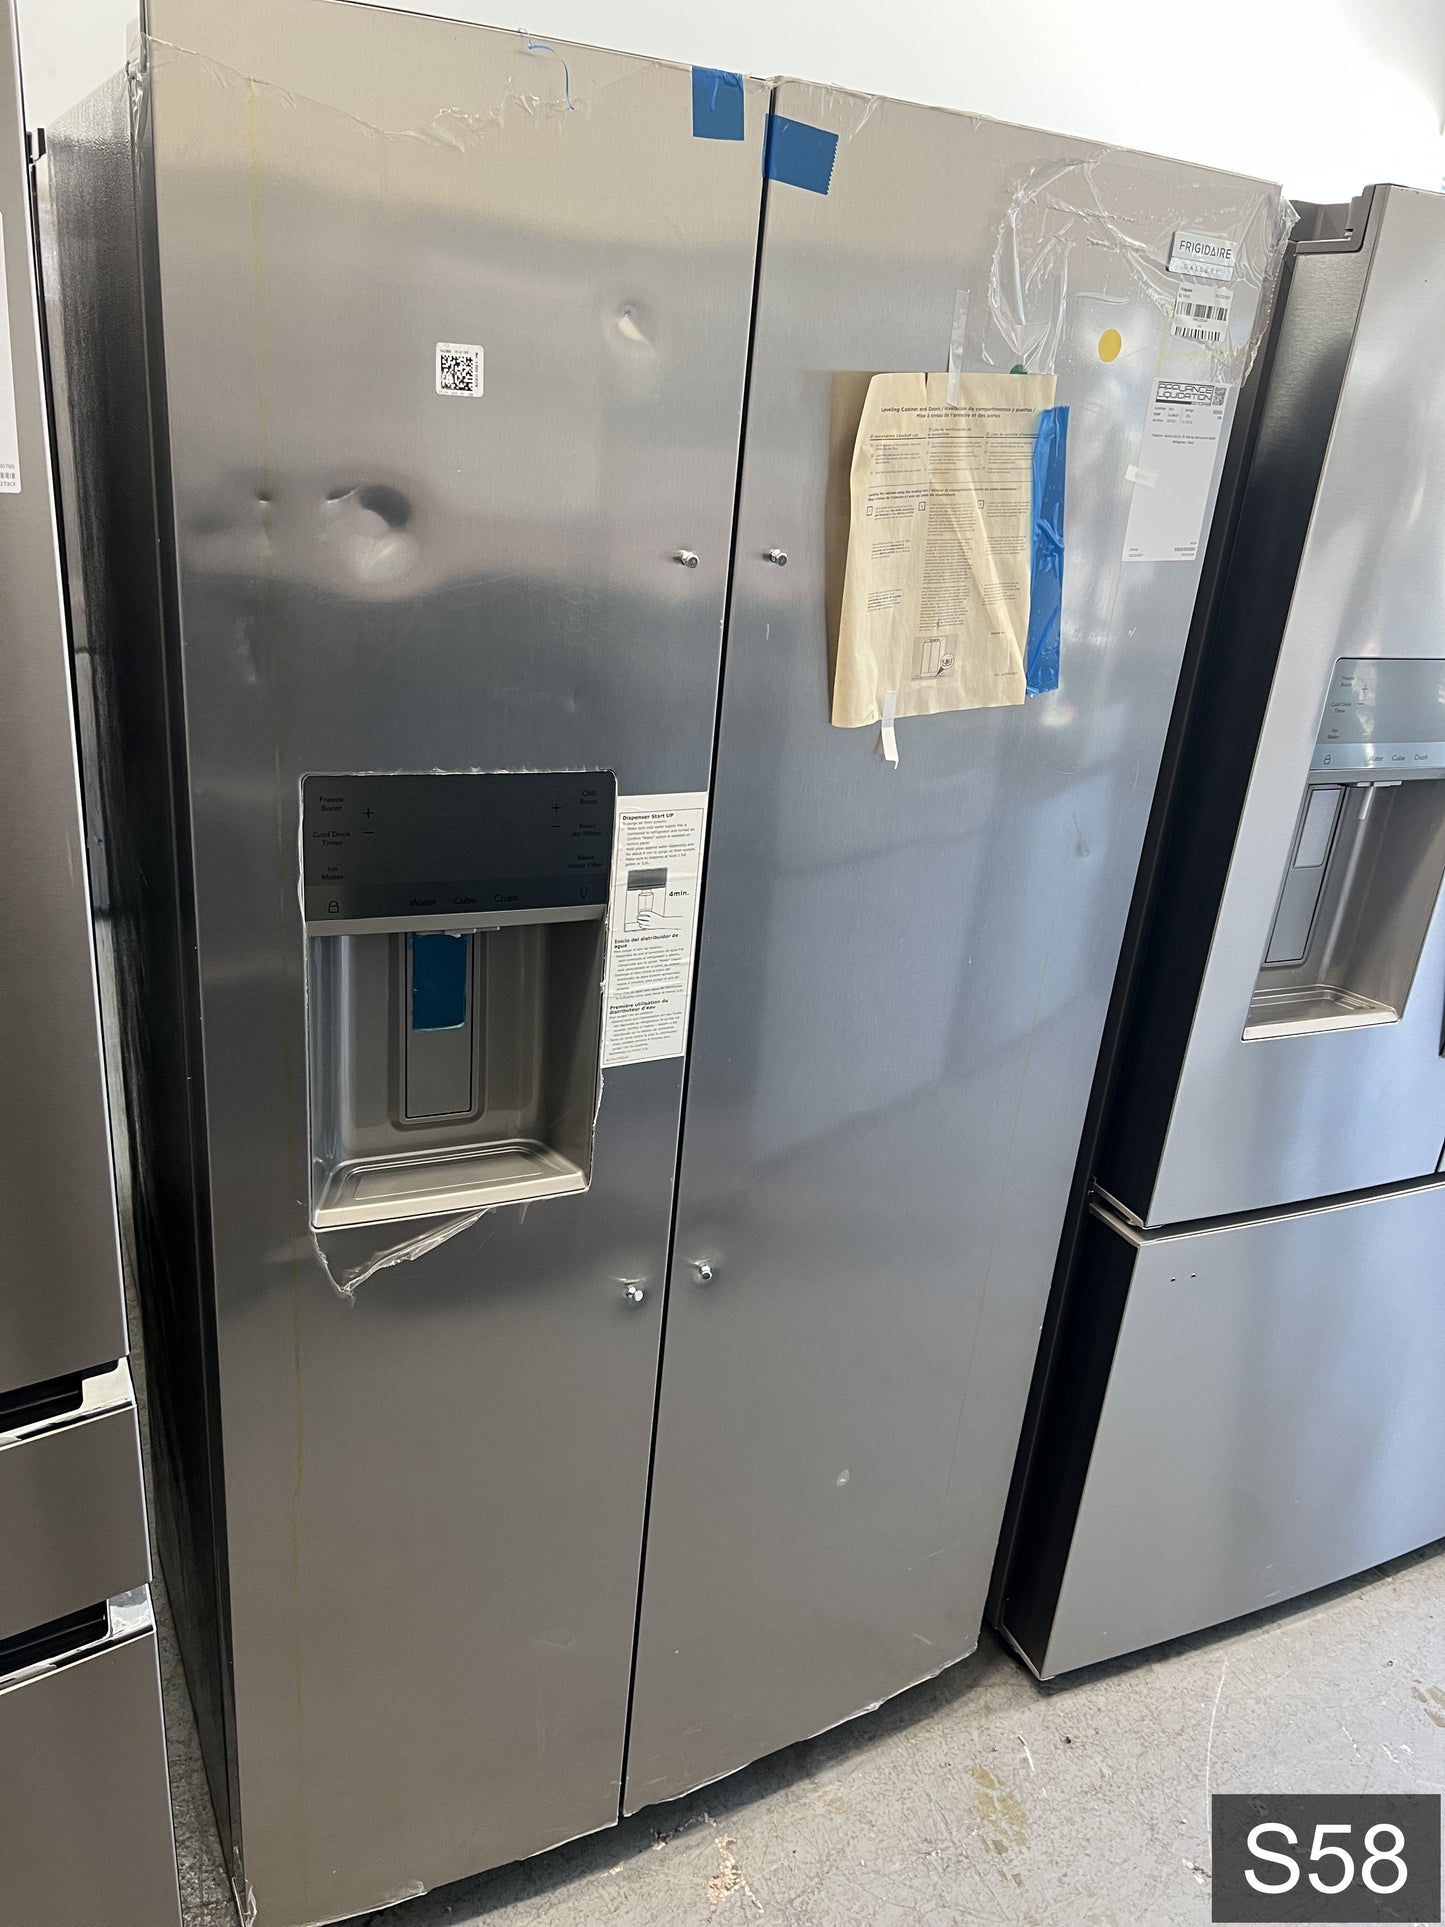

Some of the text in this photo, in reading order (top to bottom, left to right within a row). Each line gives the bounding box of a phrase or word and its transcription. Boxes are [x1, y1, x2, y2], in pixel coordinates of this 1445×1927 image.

[1180, 240, 1232, 259] FRIGIDAIRE
[1158, 383, 1214, 394] APPLIANCE
[1156, 391, 1212, 401] LIQUIDATION
[453, 896, 478, 905] Cube
[494, 894, 519, 902] Crush
[609, 1007, 640, 1015] distributeur
